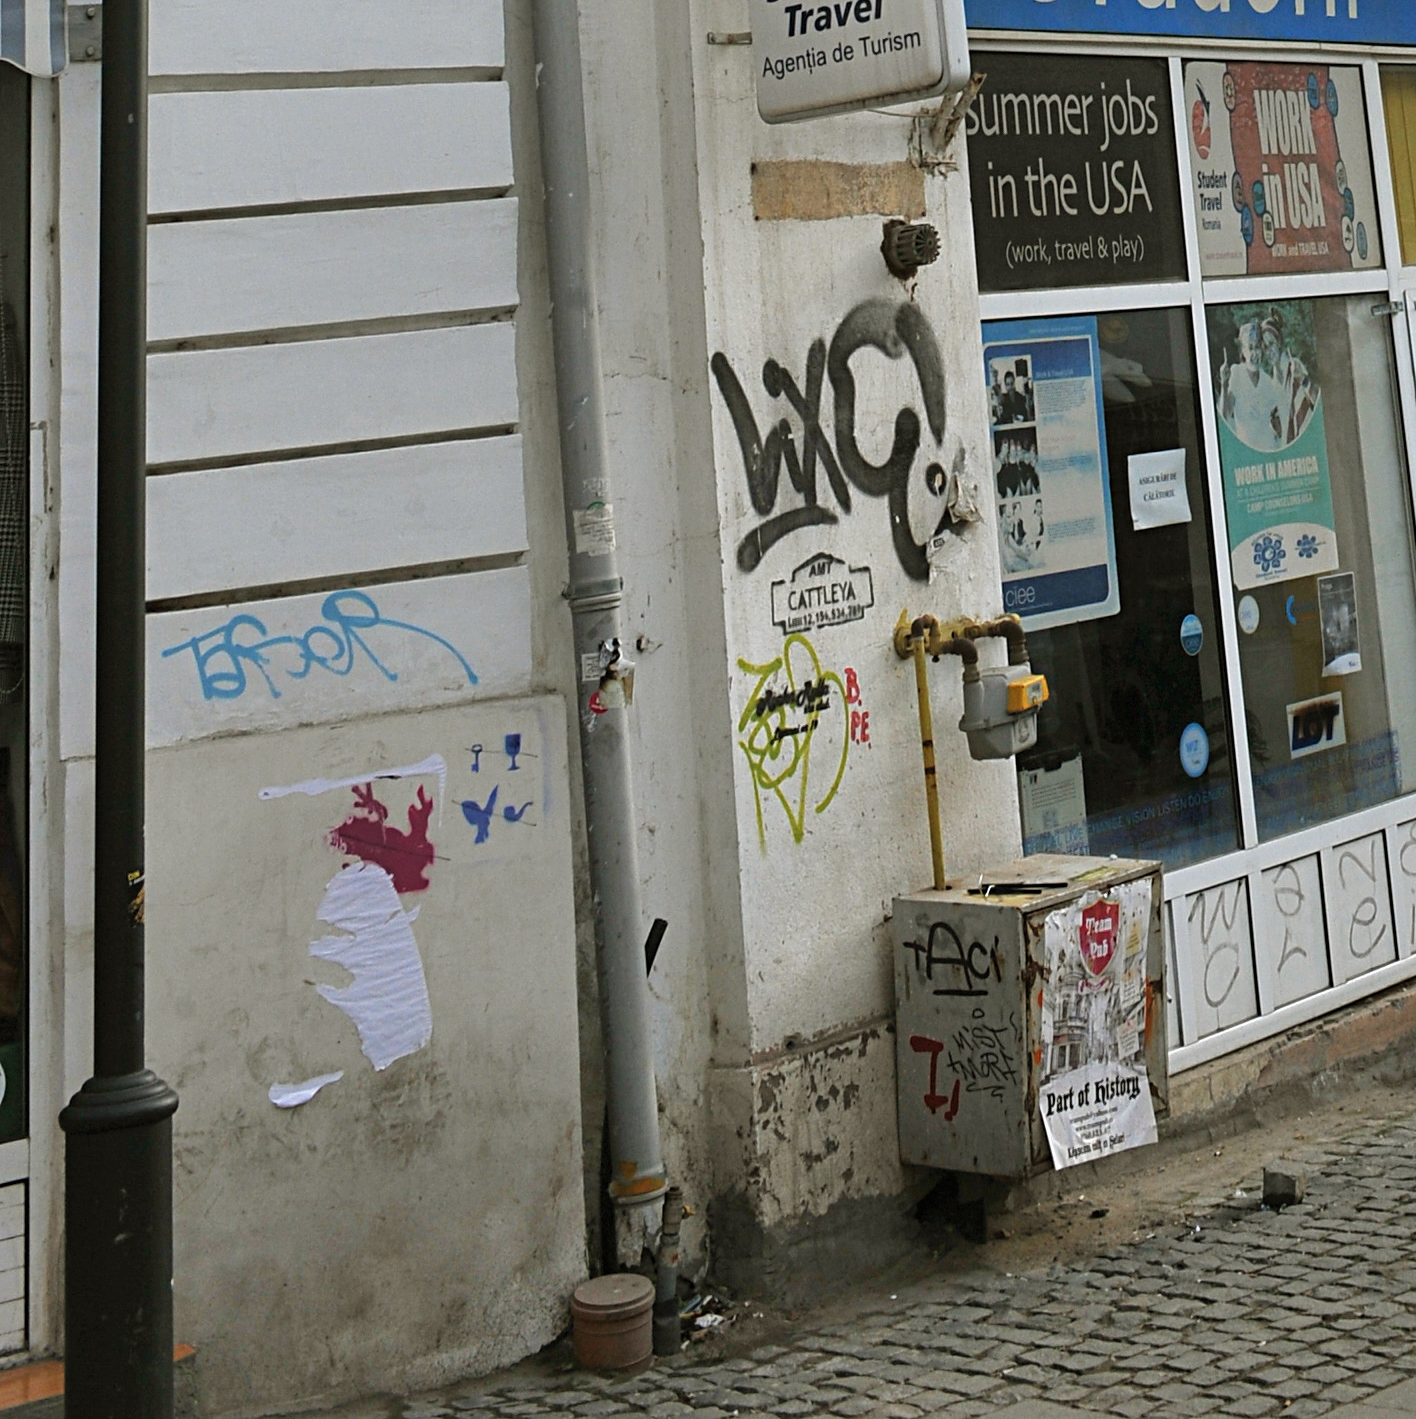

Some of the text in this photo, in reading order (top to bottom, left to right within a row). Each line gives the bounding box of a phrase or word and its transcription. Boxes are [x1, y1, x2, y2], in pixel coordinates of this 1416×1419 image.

[832, 42, 855, 63] de
[859, 31, 921, 57] Turism
[966, 78, 1159, 152] summer jobs
[1253, 89, 1318, 155] WORK
[987, 157, 1153, 219] in the USA
[1197, 169, 1228, 189] Student
[1199, 192, 1223, 212] Travel
[1262, 161, 1327, 230] in USA
[1006, 234, 1145, 269] (work, travel & play)
[1234, 456, 1319, 487] WORK IN AMERICA
[809, 562, 833, 577] AMT
[788, 581, 856, 611] CATTLEYA
[1005, 586, 1036, 607] ciee
[1086, 917, 1113, 935] Team
[1089, 939, 1109, 959] Pub
[1046, 1085, 1075, 1117] Part
[1077, 1081, 1091, 1108] of
[1094, 1075, 1141, 1106] History
